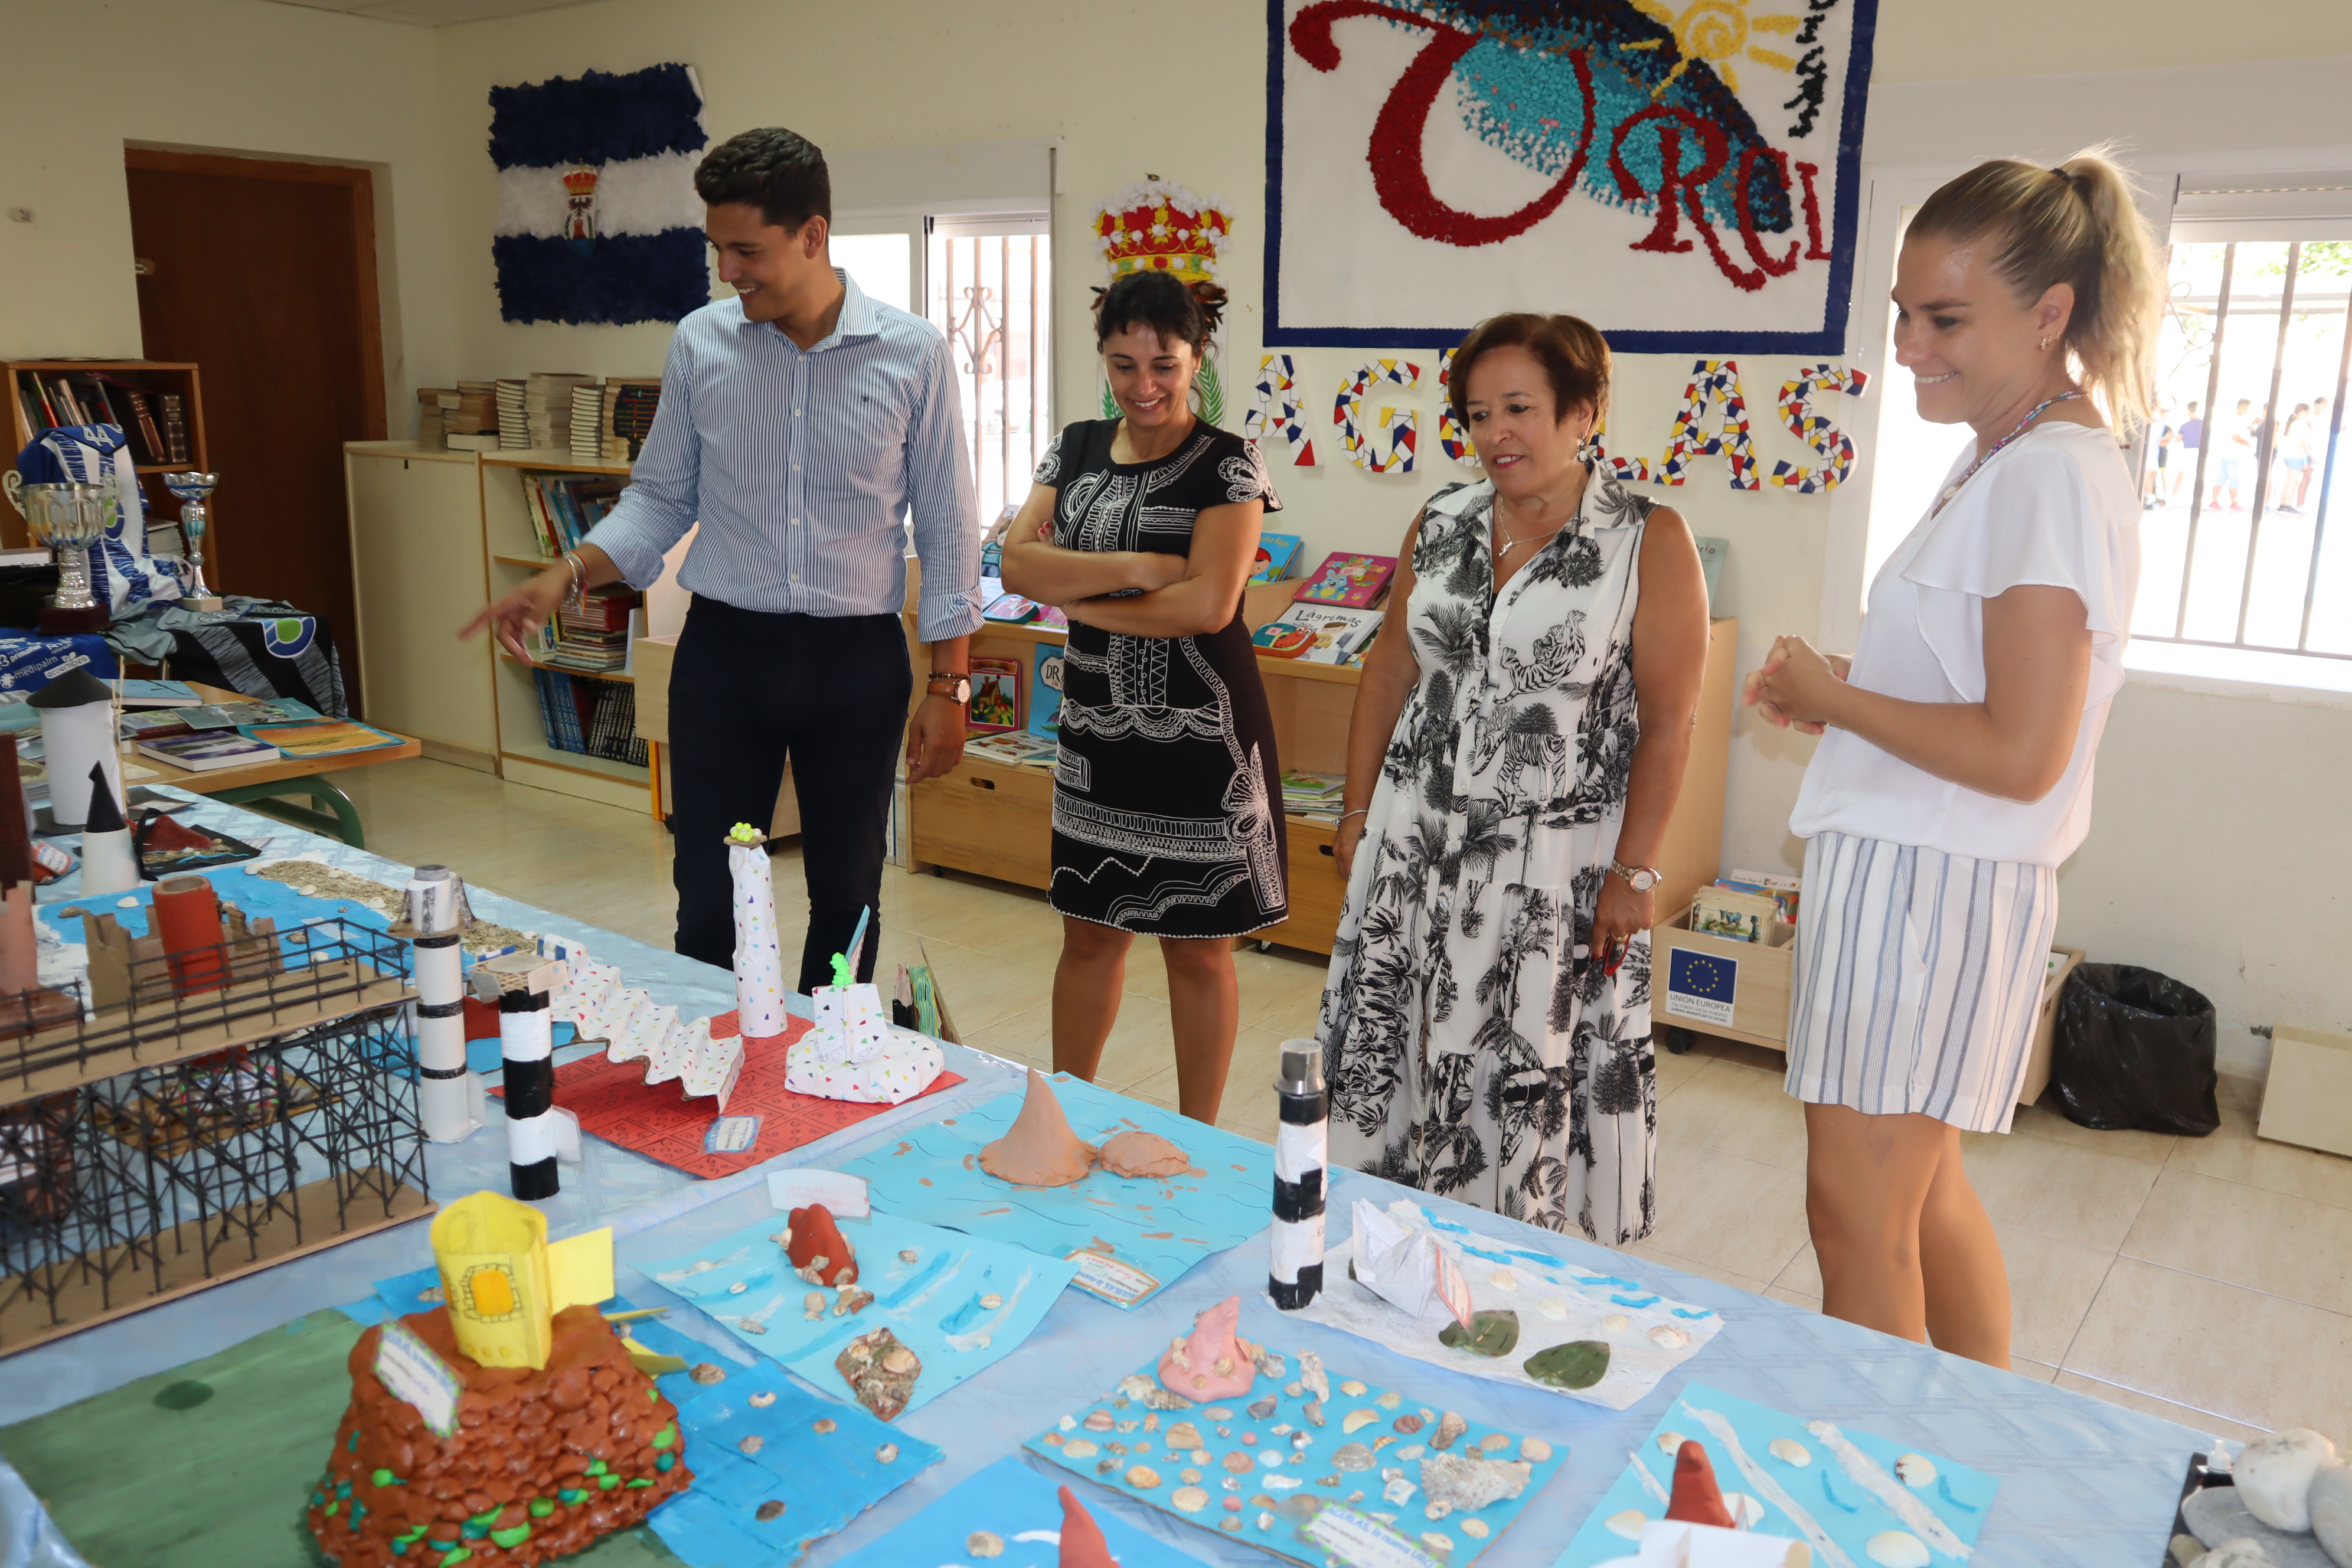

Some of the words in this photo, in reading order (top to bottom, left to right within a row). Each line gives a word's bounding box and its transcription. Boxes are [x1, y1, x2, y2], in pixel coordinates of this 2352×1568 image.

[1295, 609, 1361, 628] Lágrimas
[14, 656, 59, 680] medipalm
[47, 656, 87, 678] ecoembes
[1670, 993, 1695, 1005] UNIÓN
[1696, 999, 1730, 1012] EUROPEA
[1680, 1002, 1694, 1011] FONDO
[1709, 1010, 1728, 1018] EUROPEO
[1309, 1530, 1333, 1545] AUTOR:
[1371, 1525, 1381, 1538] la
[1381, 1534, 1410, 1554] nueva
